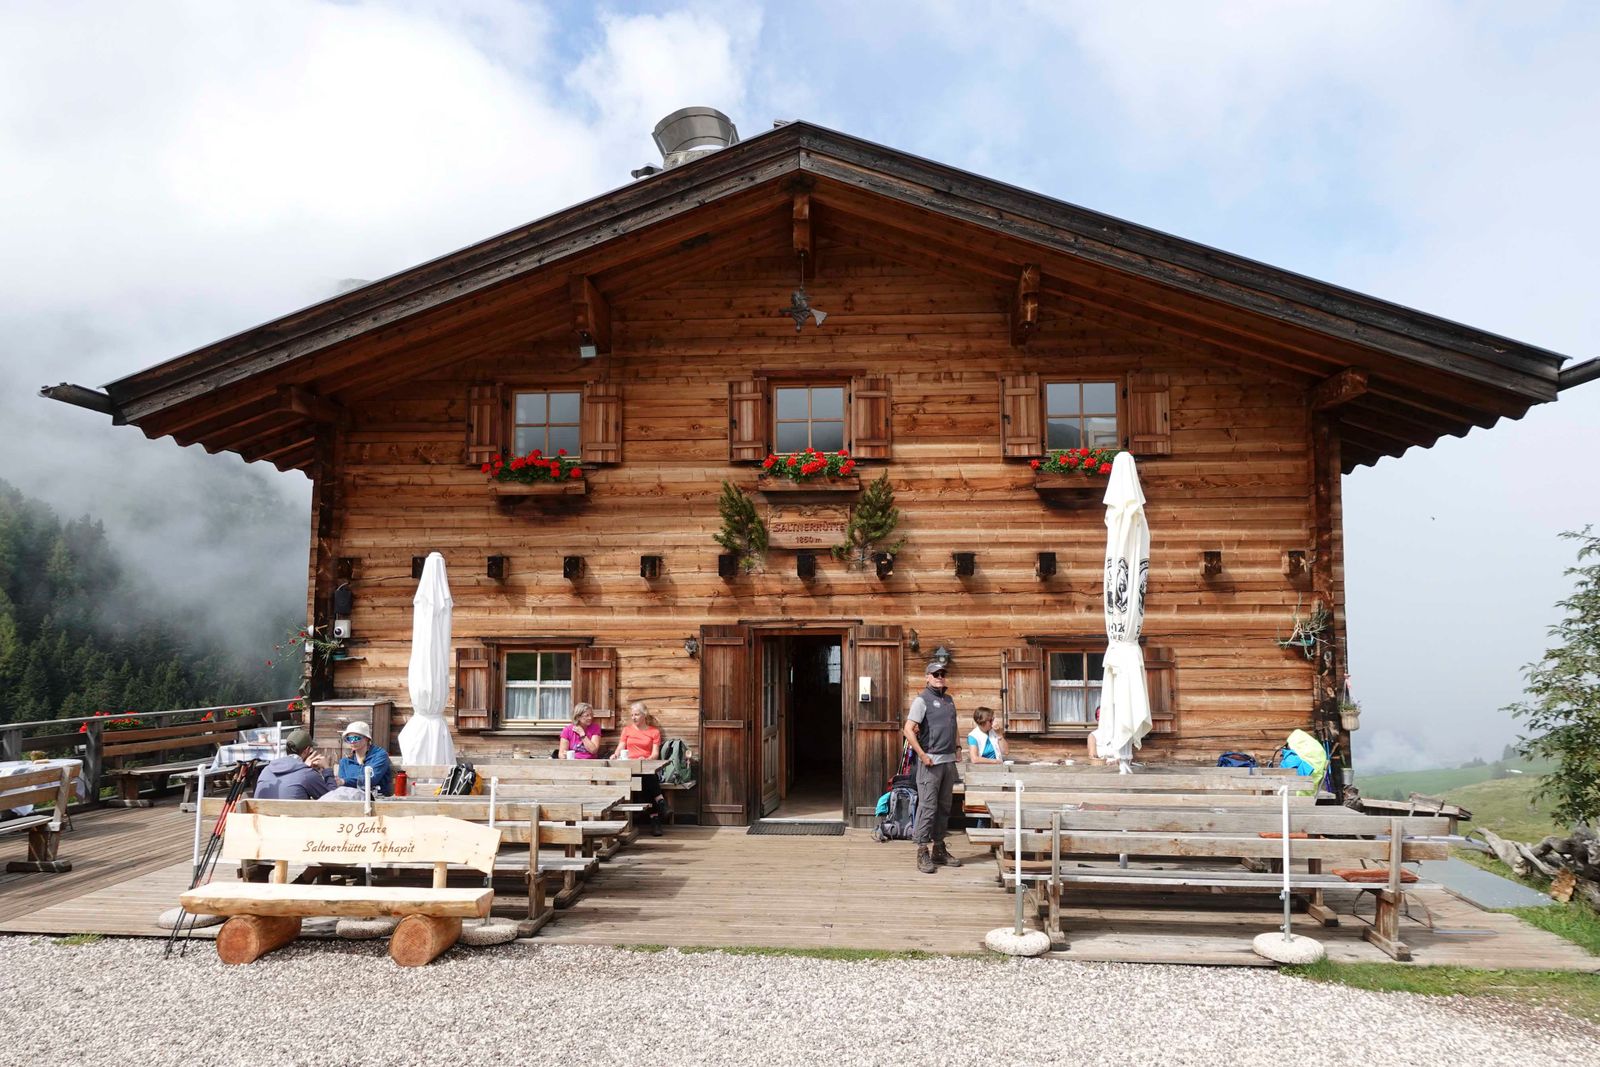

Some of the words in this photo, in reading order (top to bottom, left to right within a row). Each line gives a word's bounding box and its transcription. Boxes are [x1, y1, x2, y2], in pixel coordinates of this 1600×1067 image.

[336, 823, 354, 834] 30
[354, 822, 388, 838] Jahre
[302, 840, 367, 853] Saltnerhütte
[371, 840, 415, 857] Tschapit
